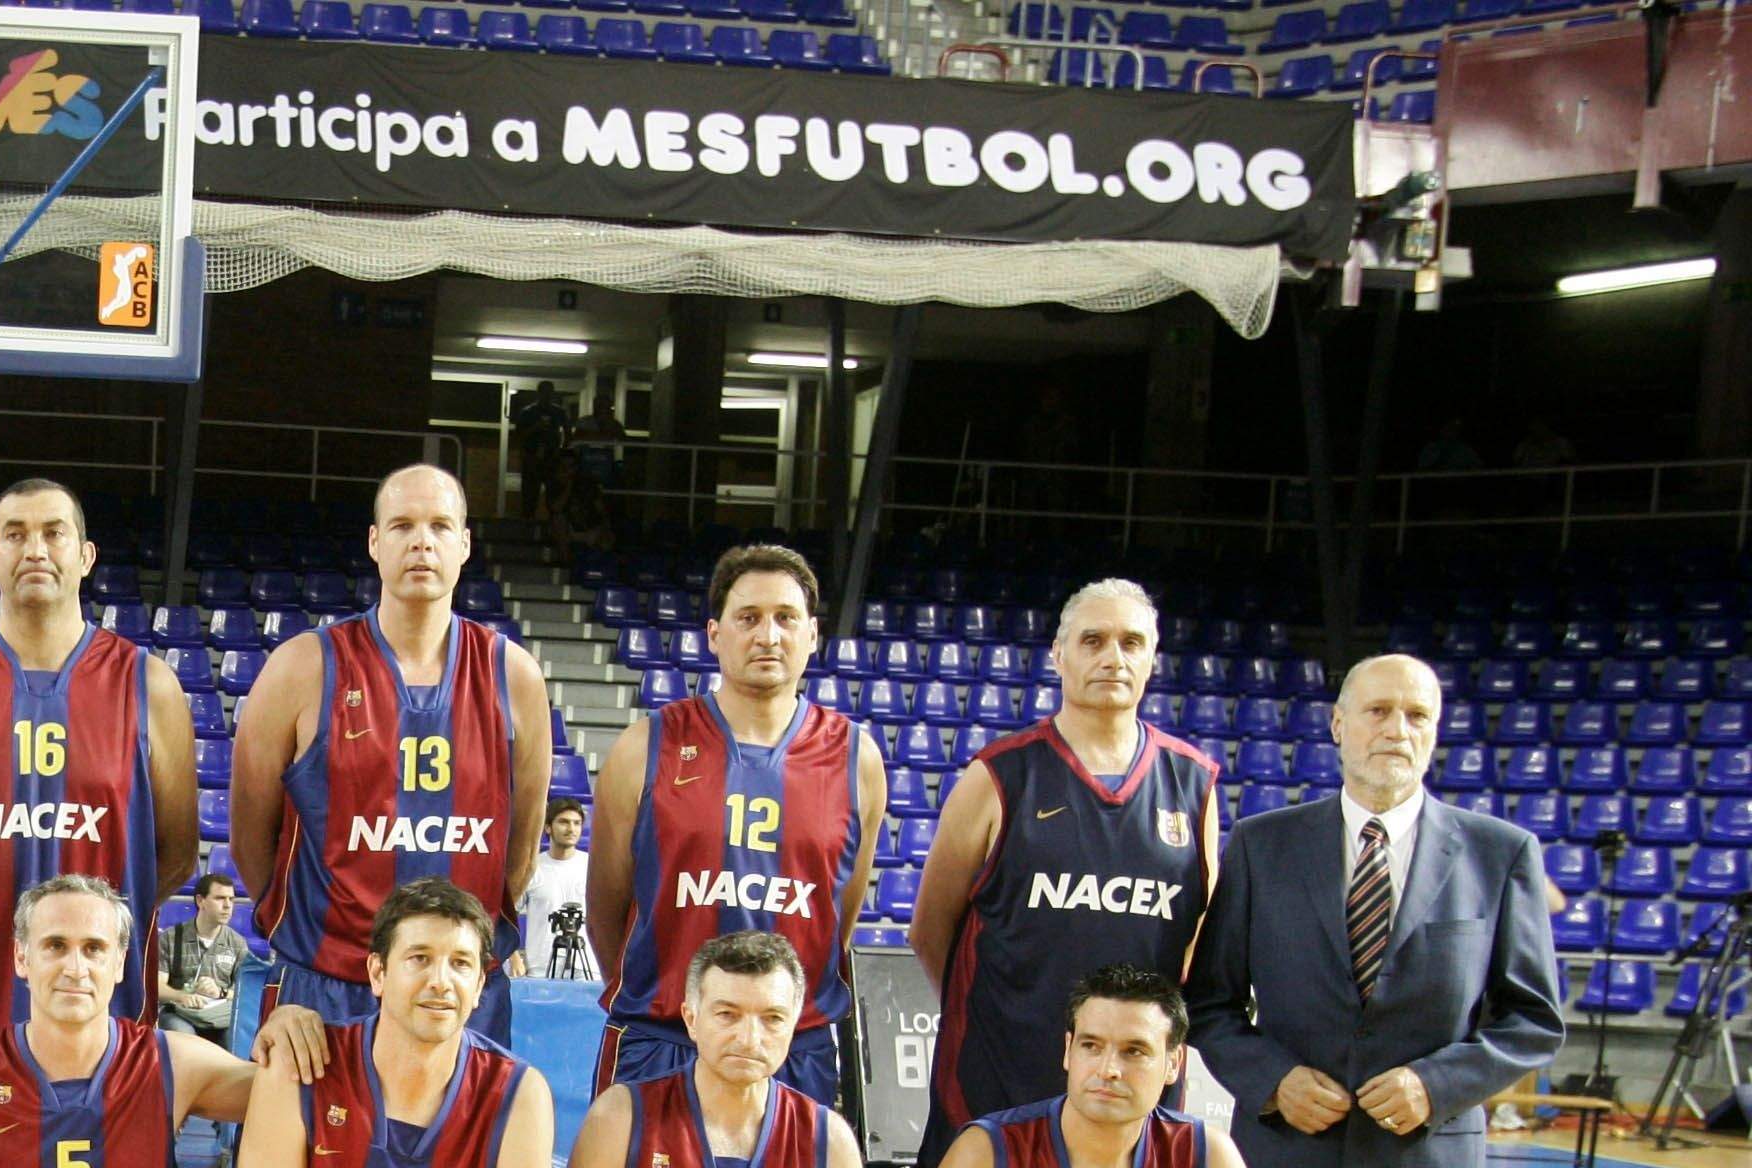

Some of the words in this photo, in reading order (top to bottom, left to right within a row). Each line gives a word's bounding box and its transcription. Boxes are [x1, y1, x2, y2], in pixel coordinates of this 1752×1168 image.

[144, 87, 469, 172] Participa
[491, 118, 539, 163] a
[561, 105, 1311, 211] MESFUTBOL.ORG
[132, 261, 149, 319] ACB
[14, 719, 67, 776] 16
[399, 735, 452, 792] 13
[346, 815, 495, 855] NACEX
[725, 793, 781, 853] 12
[675, 869, 818, 919] NACEX
[1027, 872, 1183, 921] NACEX
